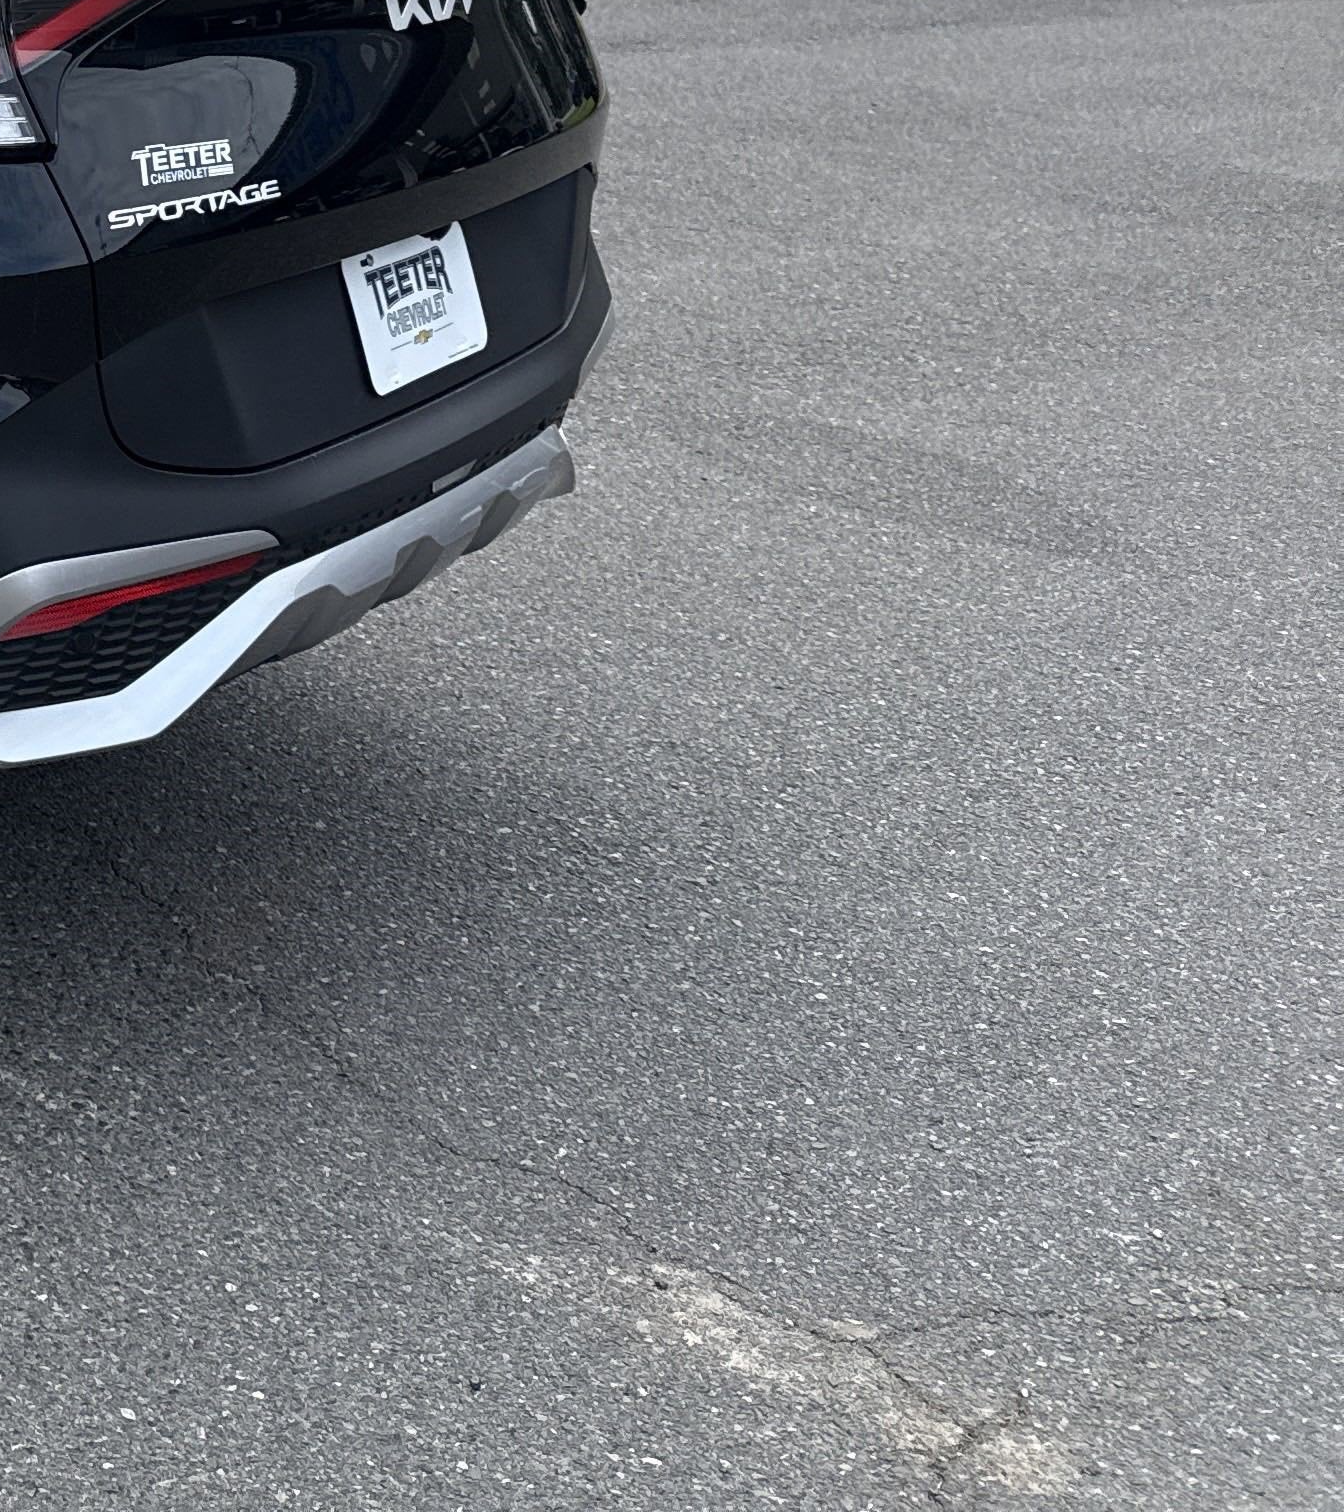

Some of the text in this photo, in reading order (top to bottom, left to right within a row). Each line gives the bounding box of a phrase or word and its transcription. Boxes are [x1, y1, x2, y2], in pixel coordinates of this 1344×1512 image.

[131, 140, 233, 187] TEETER
[150, 167, 210, 186] CHEVROLET
[107, 179, 282, 230] SPORTAGE
[363, 245, 454, 320] TEETER
[386, 291, 448, 338] CHEVROLET
